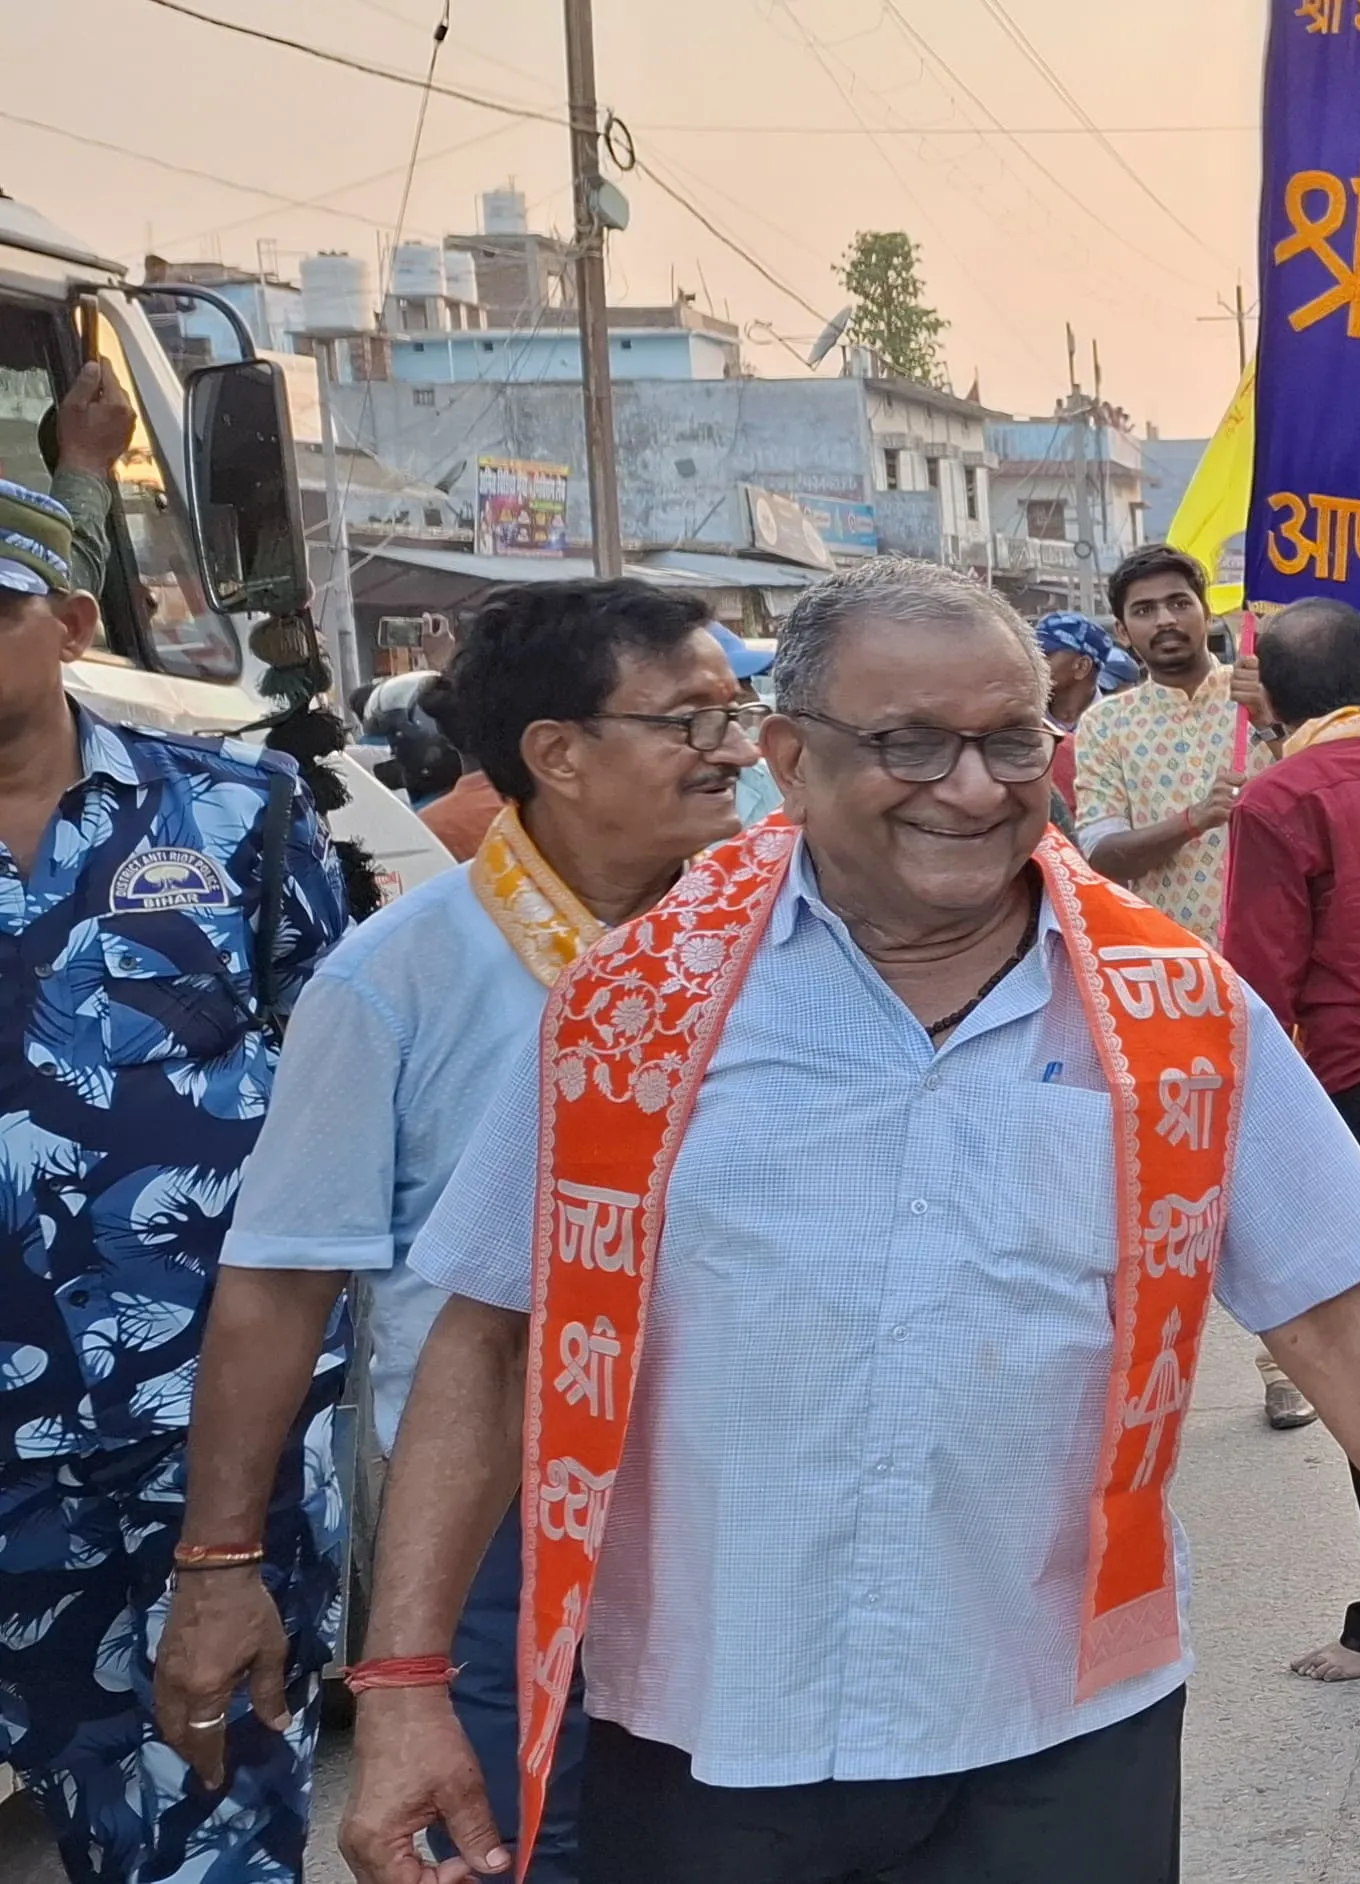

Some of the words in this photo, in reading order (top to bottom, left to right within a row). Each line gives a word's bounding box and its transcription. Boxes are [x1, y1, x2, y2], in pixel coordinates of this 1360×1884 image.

[115, 859, 142, 897] DISTRICT
[141, 851, 167, 866] ANTI
[169, 851, 193, 864] RIOT
[195, 859, 220, 891] POLICE
[143, 893, 199, 908] BIHAR
[1098, 945, 1225, 1020] जय
[1155, 1055, 1223, 1151] श्री
[557, 1179, 641, 1277] जय
[553, 1315, 622, 1421] श्री
